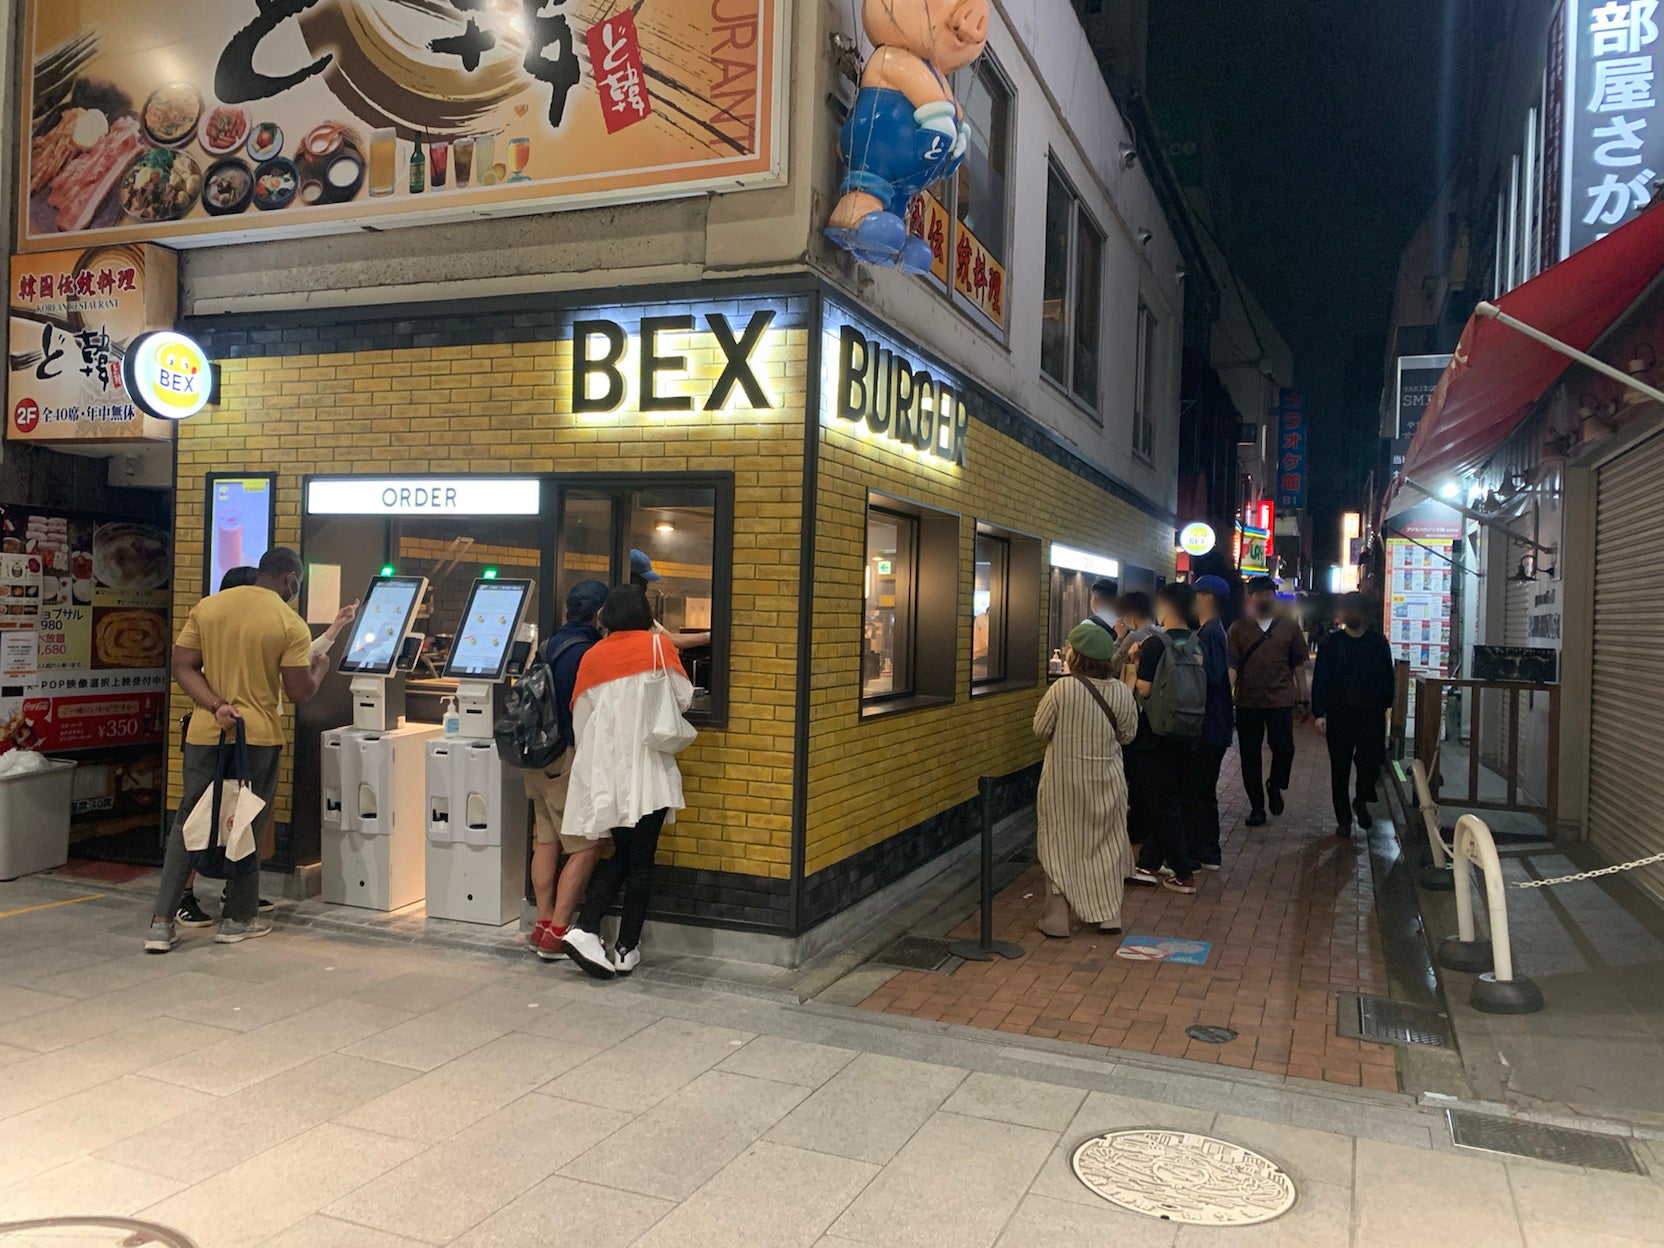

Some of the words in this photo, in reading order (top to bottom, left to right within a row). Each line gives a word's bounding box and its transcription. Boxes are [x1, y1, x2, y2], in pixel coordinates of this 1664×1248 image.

[1583, 0, 1660, 241] 部屋さが
[19, 268, 137, 302] 韓国伝統料理
[36, 302, 67, 313] KOREAN
[68, 299, 119, 311] RESTAURANT
[572, 310, 776, 413] BEX
[159, 369, 195, 392] BEX
[836, 324, 969, 467] BURGER
[17, 407, 38, 425] 2F
[1281, 393, 1303, 492] カラオケ館
[382, 487, 457, 508] ORDER
[1282, 495, 1298, 505] B1
[1189, 537, 1206, 545] BEX
[40, 620, 63, 631] 980
[97, 719, 139, 738] ¥350
